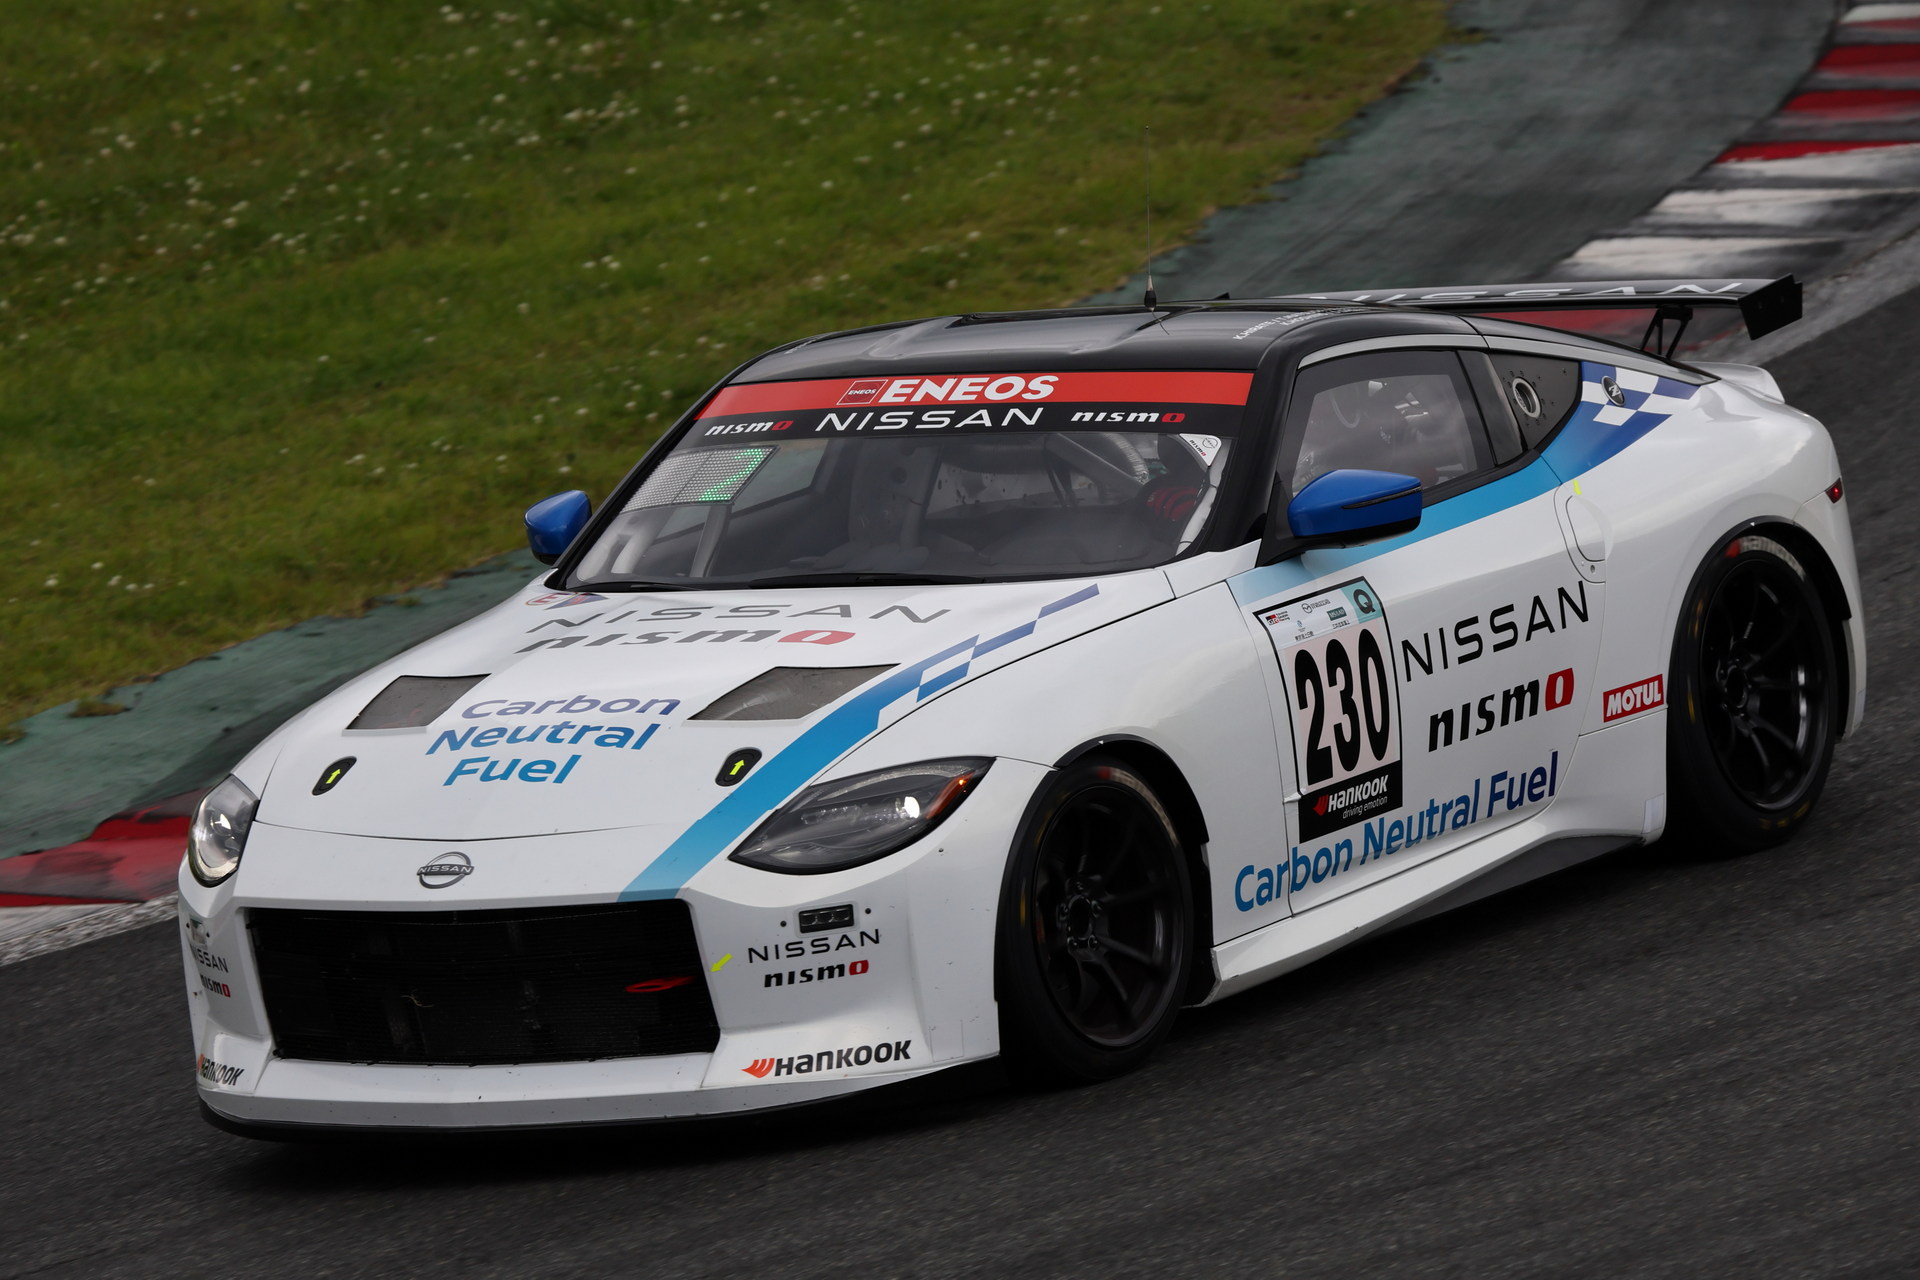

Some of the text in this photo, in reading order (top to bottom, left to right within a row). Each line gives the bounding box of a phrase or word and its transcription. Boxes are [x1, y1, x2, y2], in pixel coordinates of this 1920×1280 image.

[1309, 283, 1744, 304] ISSAN
[848, 375, 1059, 404] ENEOS ENEOS
[814, 407, 1044, 432] NISSAN
[1353, 588, 1376, 615] Q
[526, 604, 952, 633] NISSAN
[1401, 580, 1589, 683] NISSAN
[461, 695, 681, 719] Carbon
[1294, 628, 1390, 786] 230
[1606, 679, 1662, 718] MOTUL
[425, 720, 661, 755] Neutral
[442, 755, 582, 787] Fuel
[1342, 796, 1388, 819] driving emotion
[1234, 751, 1558, 912] Carbon Neutral Fuel
[419, 864, 472, 873] NISSAN
[748, 929, 880, 963] NISSAN
